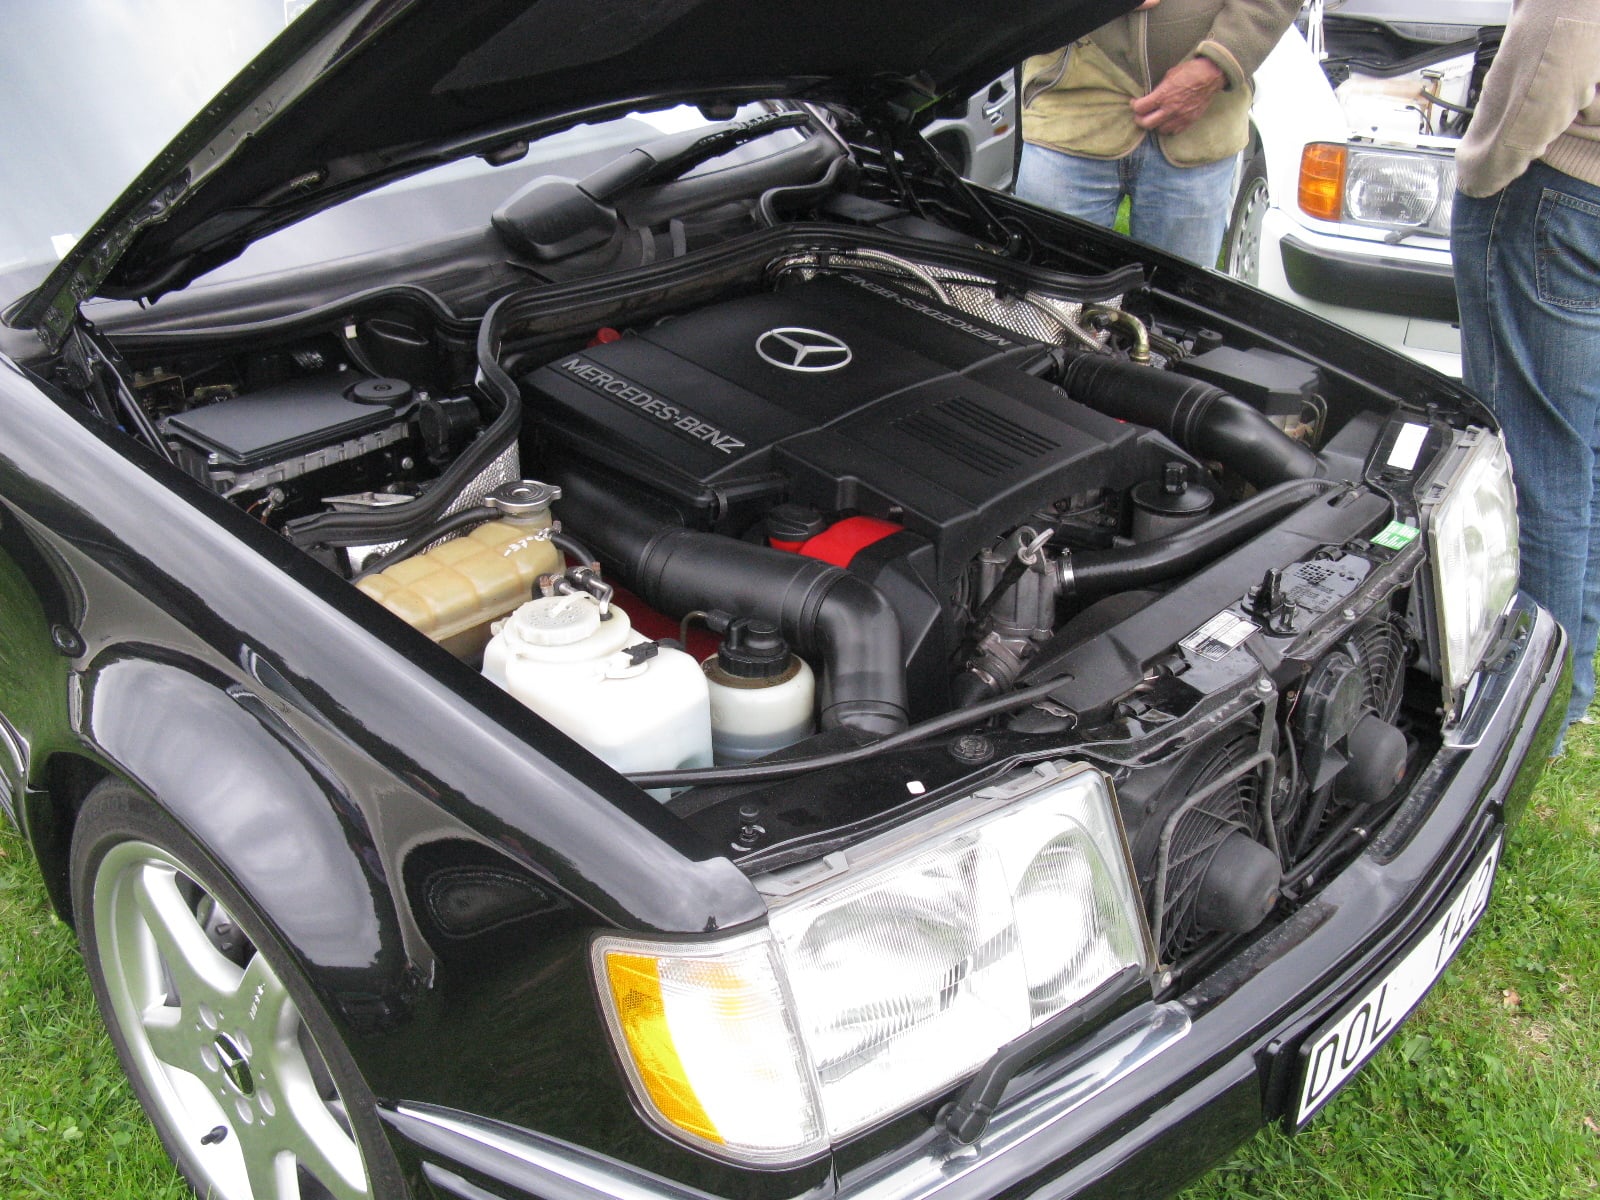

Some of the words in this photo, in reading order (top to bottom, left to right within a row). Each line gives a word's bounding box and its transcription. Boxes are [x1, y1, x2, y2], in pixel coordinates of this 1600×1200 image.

[561, 358, 746, 455] MERCEDES-BENZ
[1304, 983, 1392, 1109] DOL
[1434, 856, 1492, 971] 142
